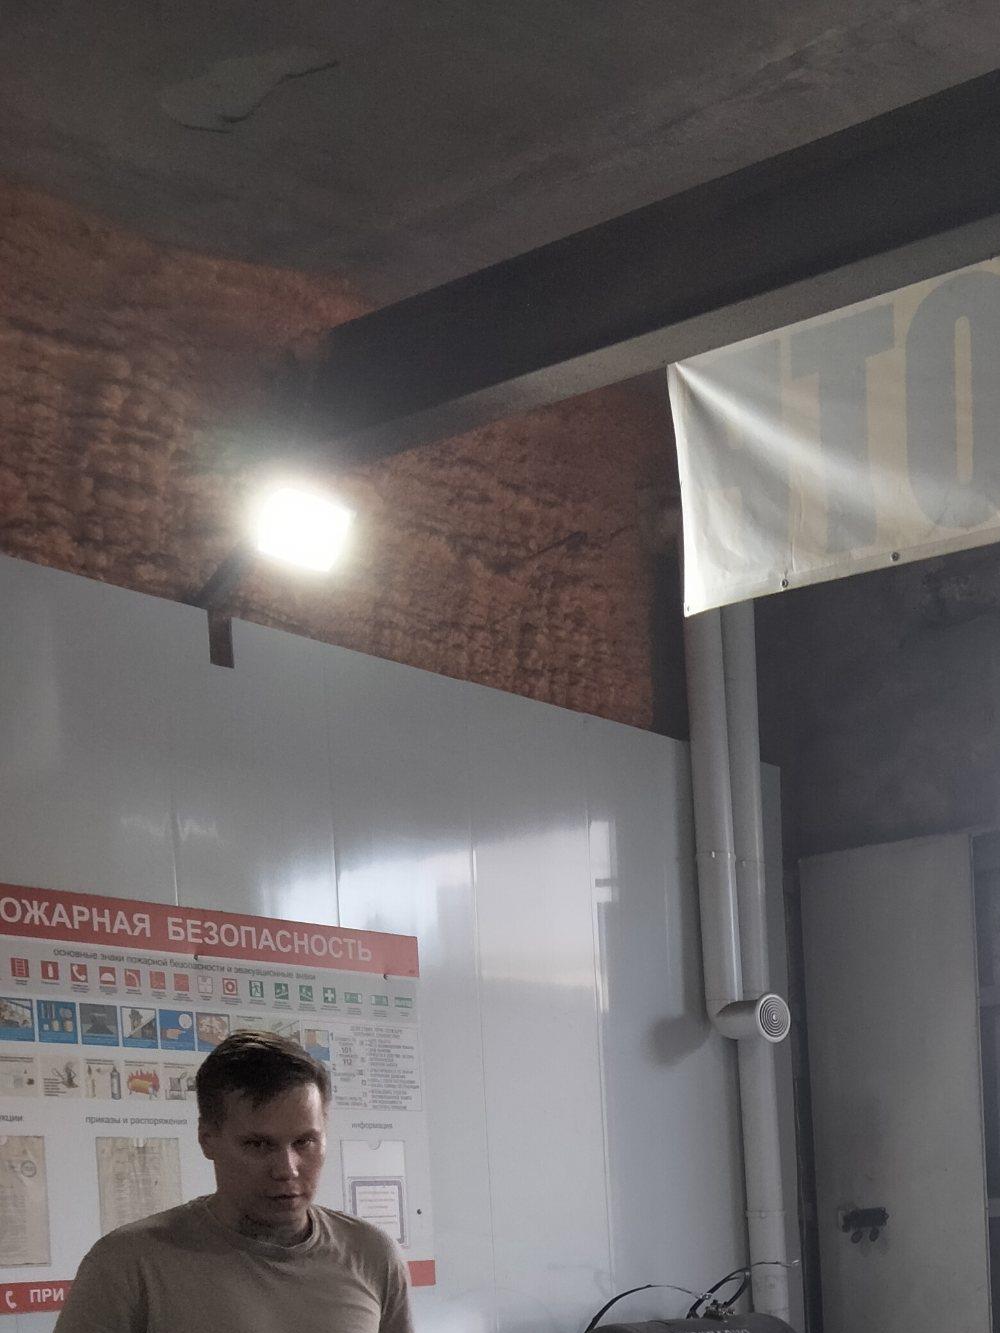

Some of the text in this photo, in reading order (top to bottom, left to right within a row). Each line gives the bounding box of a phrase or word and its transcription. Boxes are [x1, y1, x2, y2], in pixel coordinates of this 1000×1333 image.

[0, 896, 373, 962] ОЖАРНАЯ БЕЗОПАСНОСТЬ
[53, 948, 98, 960] основные
[100, 953, 125, 963] знаки
[127, 955, 168, 967] пожарной
[85, 1116, 121, 1125] приказы
[130, 1118, 188, 1126] распоряжения
[351, 1121, 394, 1130] информация
[30, 1288, 65, 1303] ПРИ
